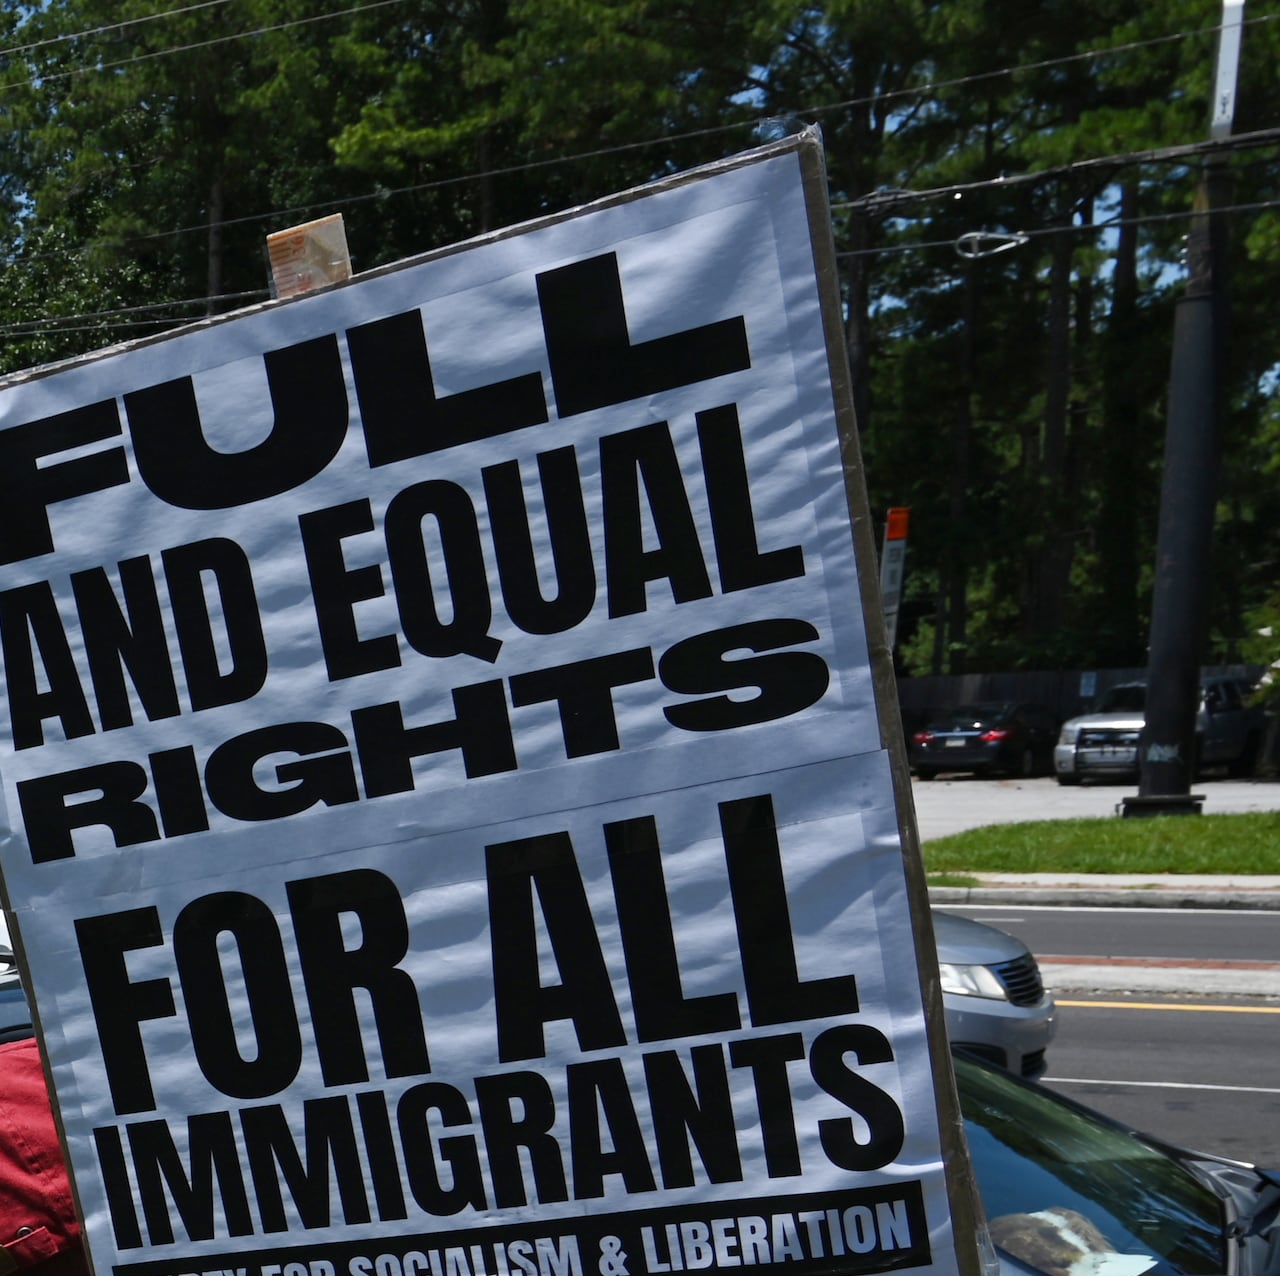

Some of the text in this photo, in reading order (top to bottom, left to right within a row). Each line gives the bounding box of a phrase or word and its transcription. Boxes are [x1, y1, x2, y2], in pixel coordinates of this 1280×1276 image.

[298, 402, 806, 684] EQUAL
[16, 617, 830, 864] RIGHTS
[74, 793, 859, 1116] FOR ALL
[93, 1023, 906, 1249] IMMIGRANTS
[644, 1200, 913, 1274] LIBERATION
